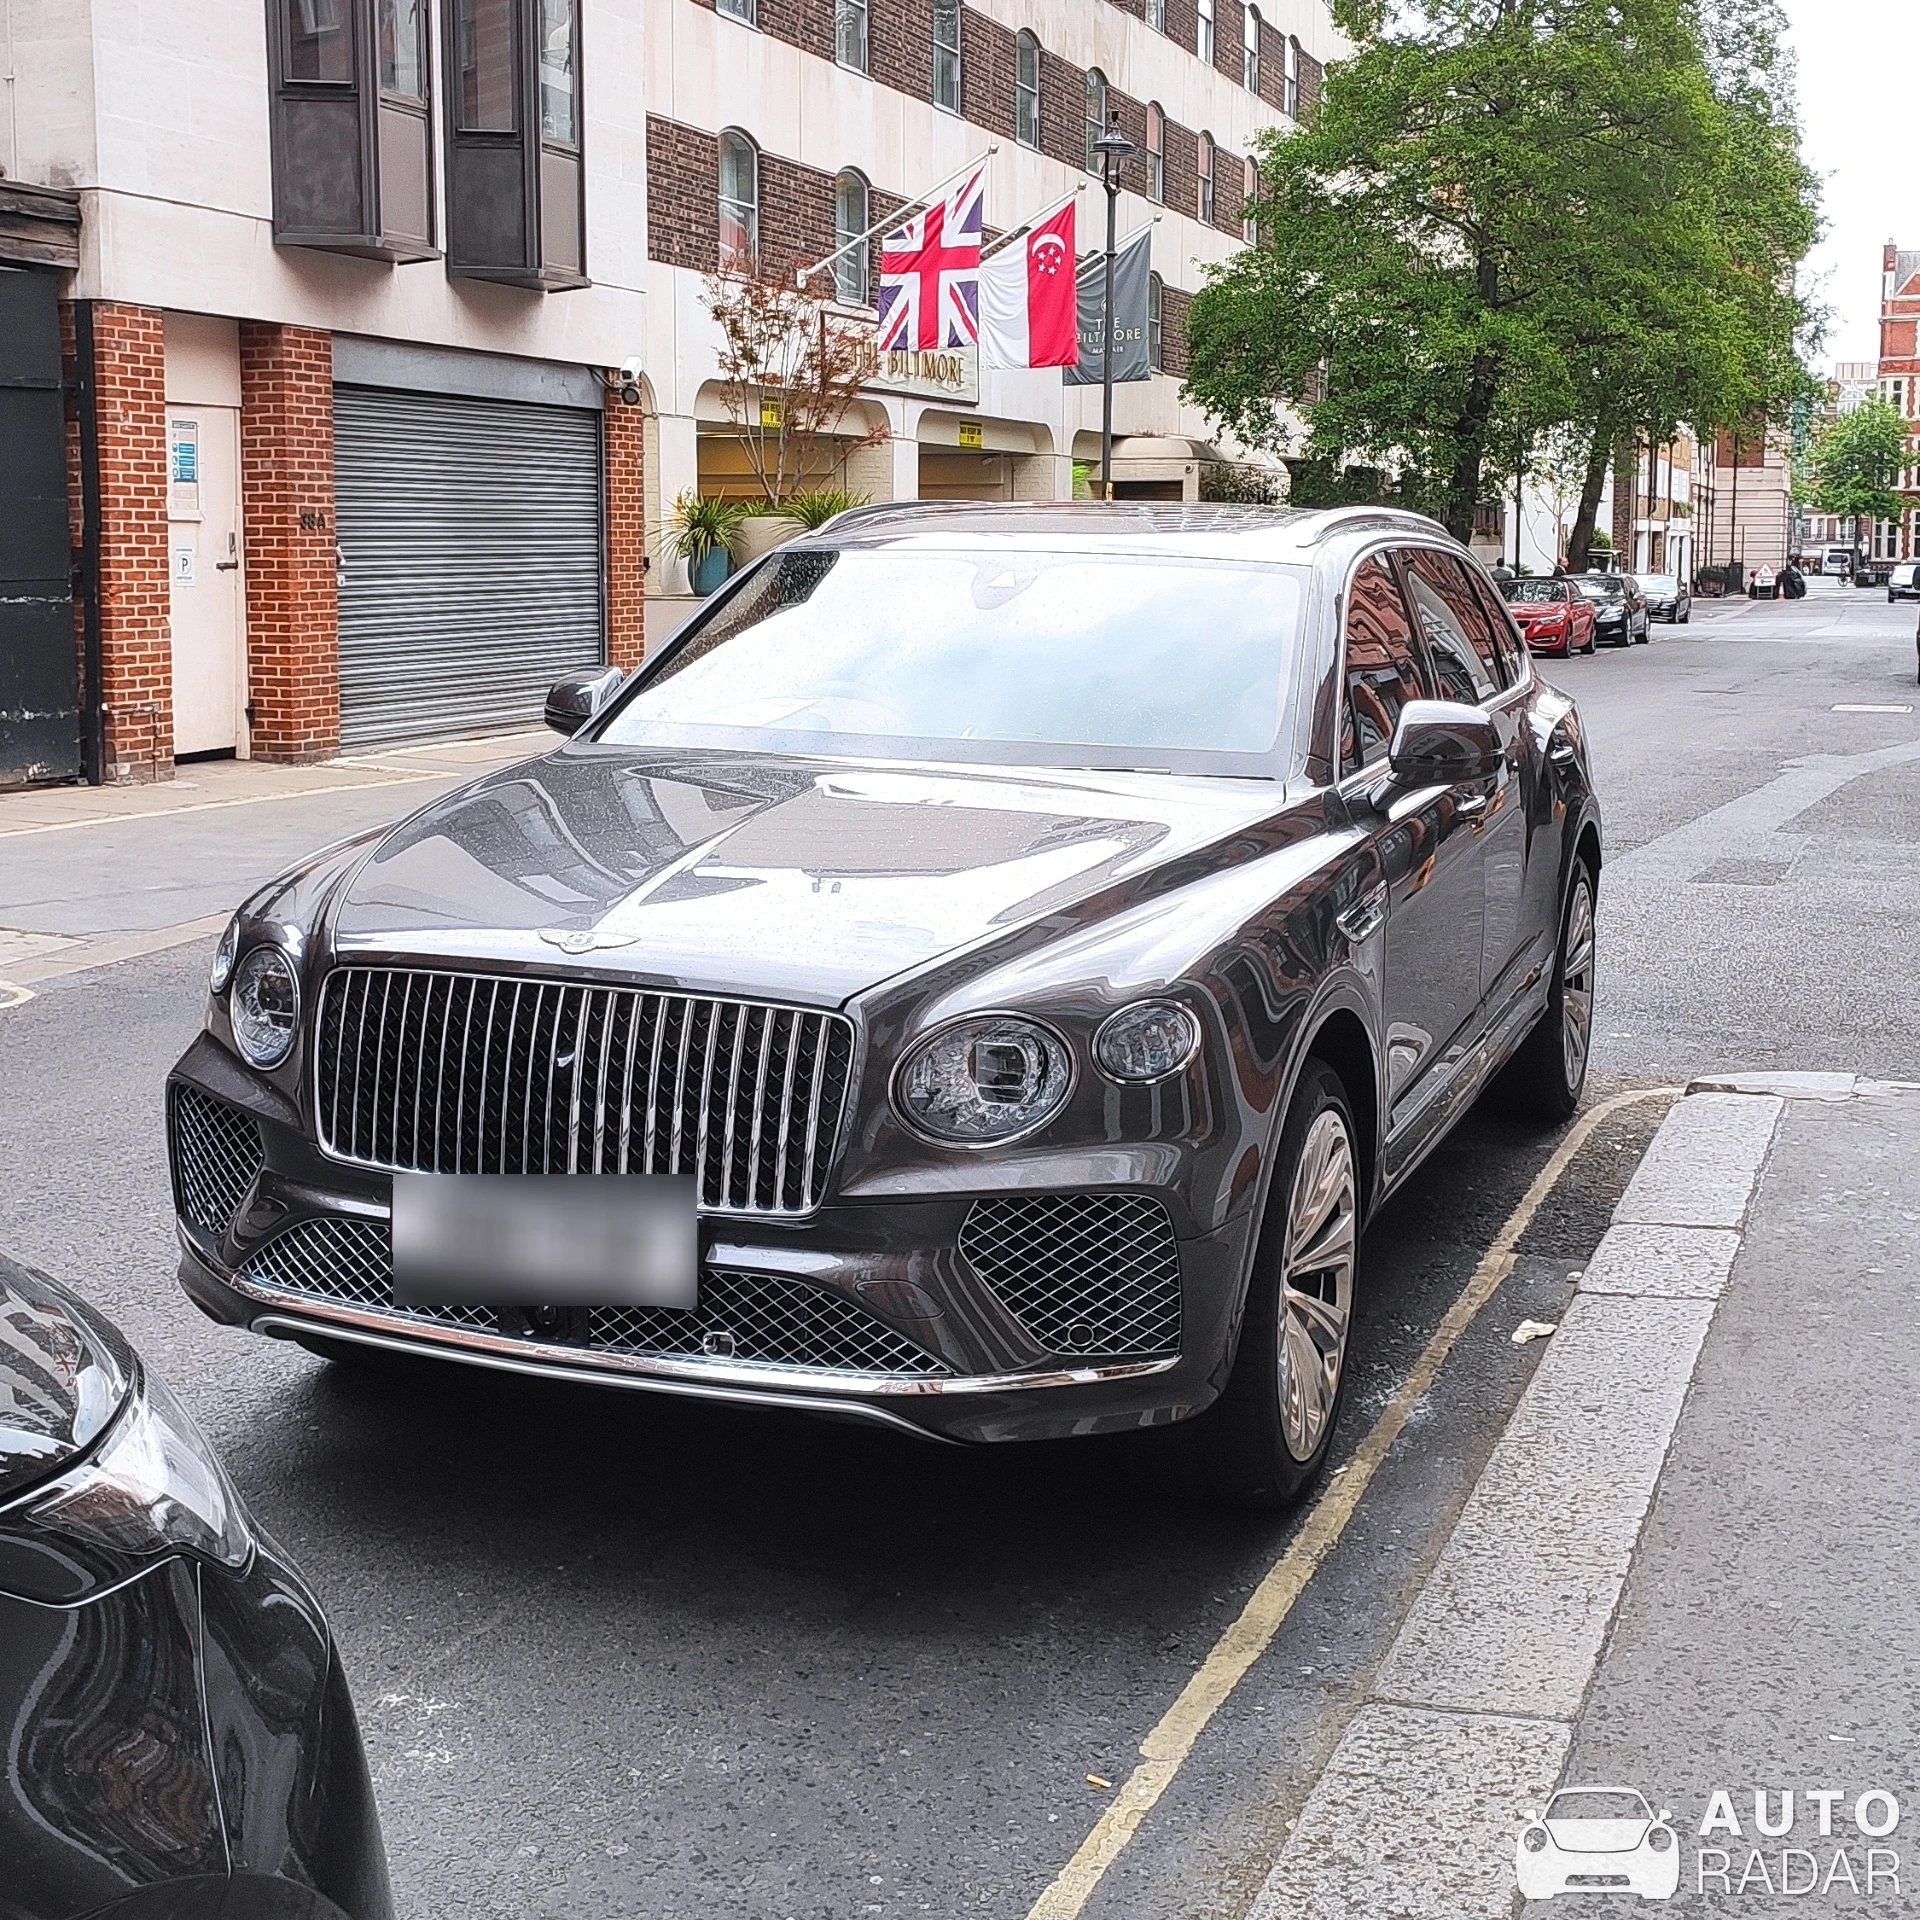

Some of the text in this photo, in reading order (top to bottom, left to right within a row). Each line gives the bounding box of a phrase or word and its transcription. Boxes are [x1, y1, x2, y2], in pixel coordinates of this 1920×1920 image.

[1095, 317, 1120, 330] TE
[1092, 345, 1124, 354] MAAIR
[888, 350, 965, 383] BILTMORE
